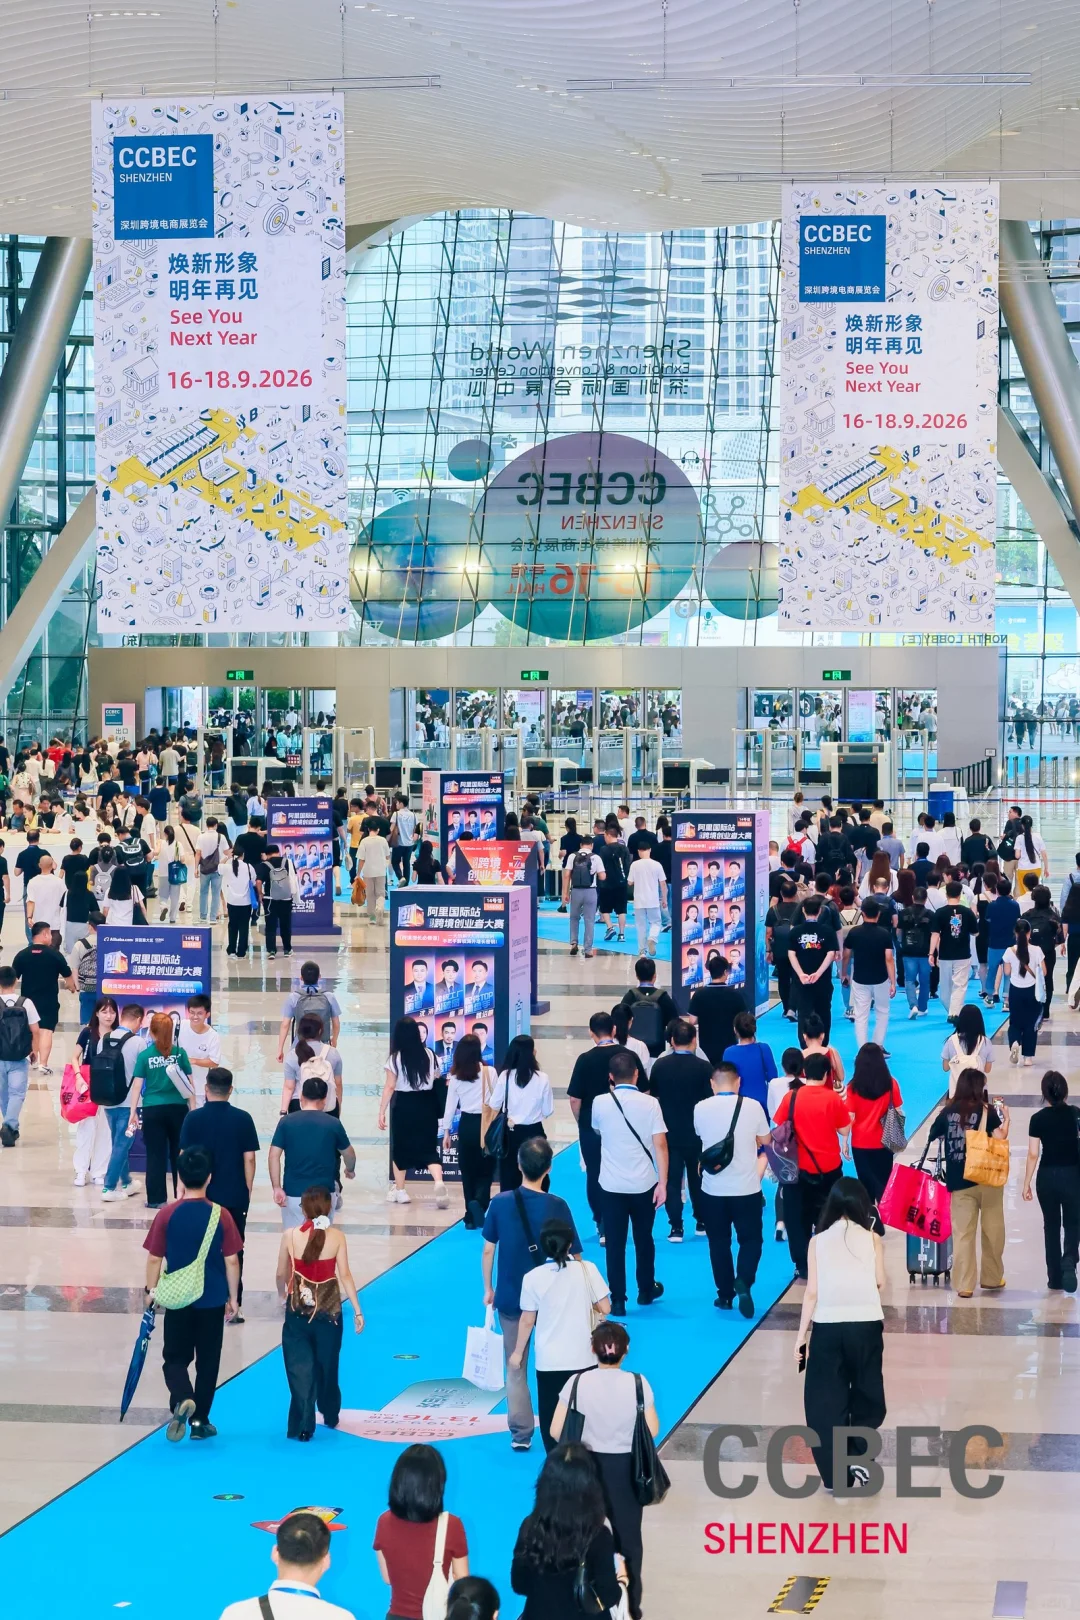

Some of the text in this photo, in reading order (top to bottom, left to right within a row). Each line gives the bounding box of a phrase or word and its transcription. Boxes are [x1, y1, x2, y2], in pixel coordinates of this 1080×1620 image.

[118, 145, 197, 169] CCBEC
[119, 172, 173, 183] SHENZHEN
[120, 218, 208, 231] 深圳跨境电商展览会
[804, 224, 872, 243] CCBEC
[804, 246, 851, 255] SHENZHEN
[168, 251, 259, 275] 焕新形象
[169, 279, 259, 301] 明年再见
[804, 285, 880, 295] 深圳跨境电商展览会
[170, 308, 243, 325] See You
[845, 314, 923, 333] 焕新形象
[170, 330, 258, 346] Next Year
[845, 336, 923, 355] 明年再见
[845, 361, 909, 375] See You
[167, 368, 313, 390] 16-18.9.2026
[845, 379, 921, 393] Next Year
[842, 413, 968, 429] 16-18.9.2026
[697, 823, 736, 832] 阿里国际站
[467, 869, 526, 881] 创业者大赛
[427, 906, 481, 917] 阿里国际站
[434, 918, 505, 929] 跨境创业者大赛
[131, 954, 181, 965] 阿里国际站
[136, 966, 202, 977] 跨境创业者大赛
[363, 1429, 454, 1438] CCBEC
